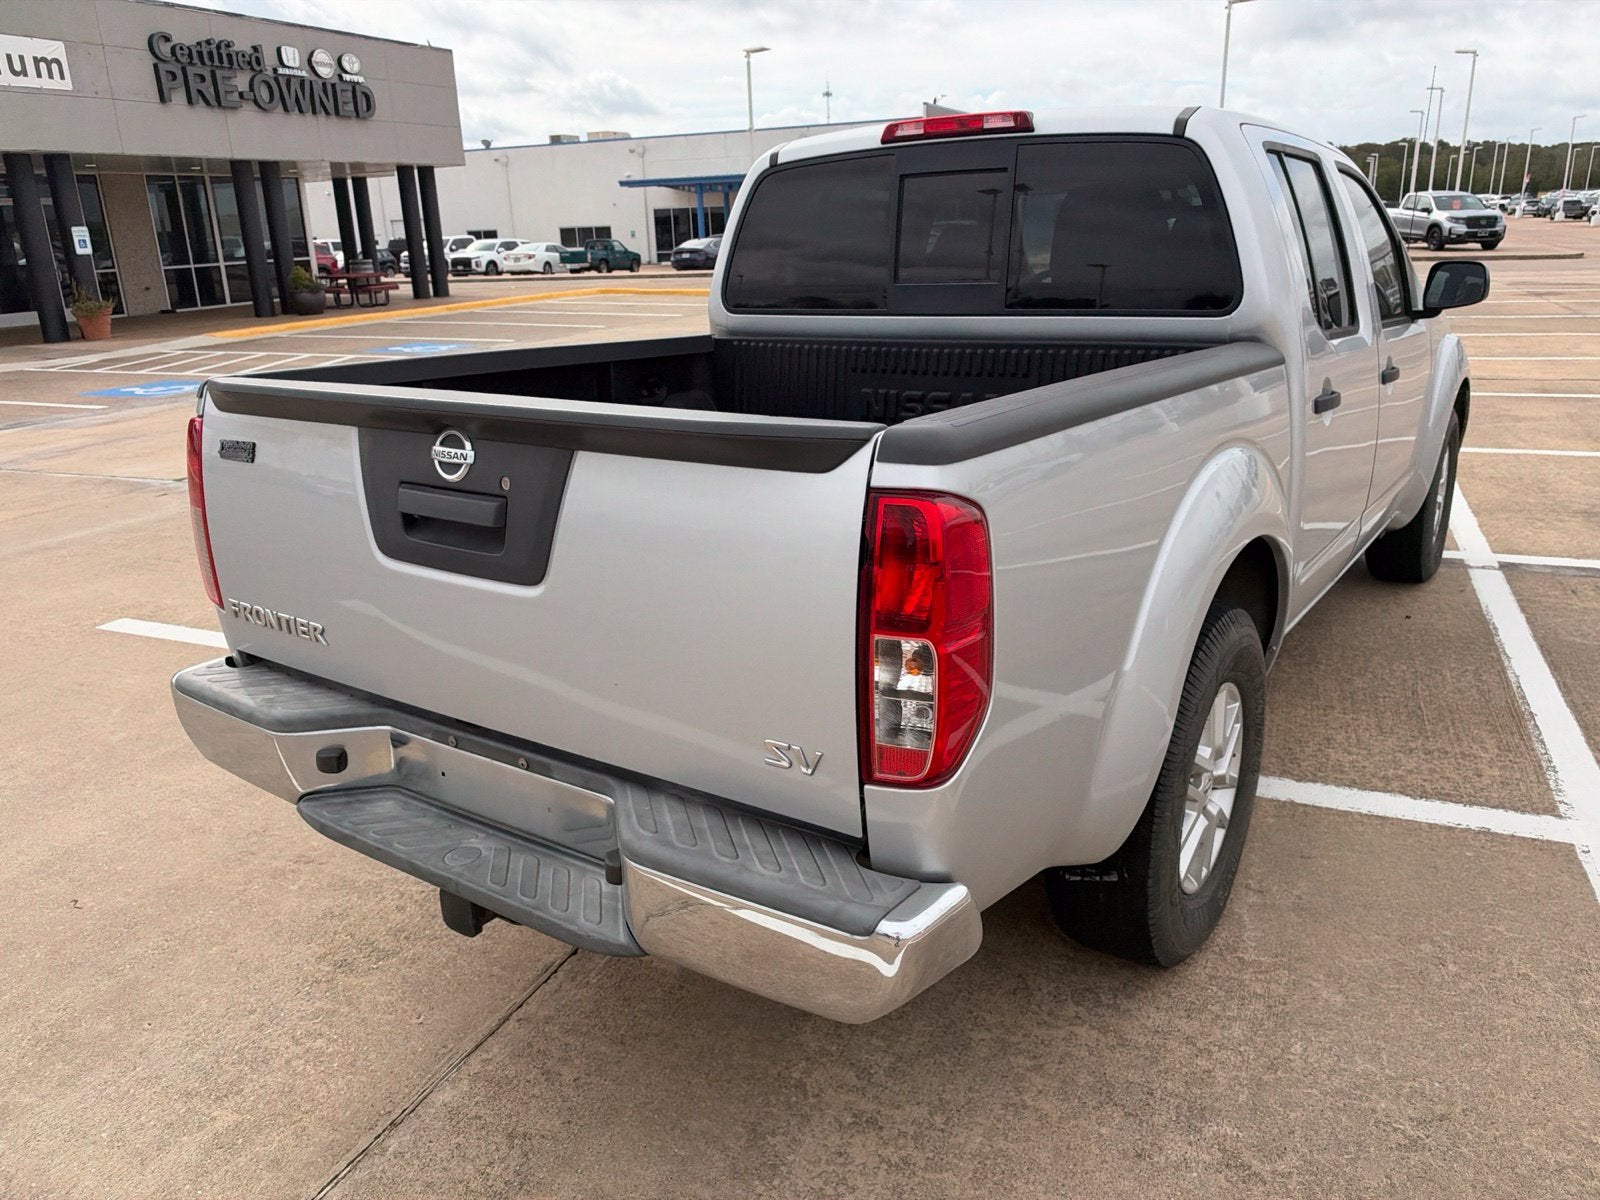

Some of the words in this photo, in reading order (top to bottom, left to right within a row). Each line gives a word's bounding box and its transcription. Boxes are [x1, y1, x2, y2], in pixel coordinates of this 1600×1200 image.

[0, 53, 65, 81] um
[147, 31, 268, 72] Certified
[153, 61, 377, 120] PRE-OWNED
[861, 388, 1001, 422] NISS
[433, 448, 469, 461] NISSAN
[228, 597, 330, 646] FRONTIER
[763, 738, 824, 777] SV
